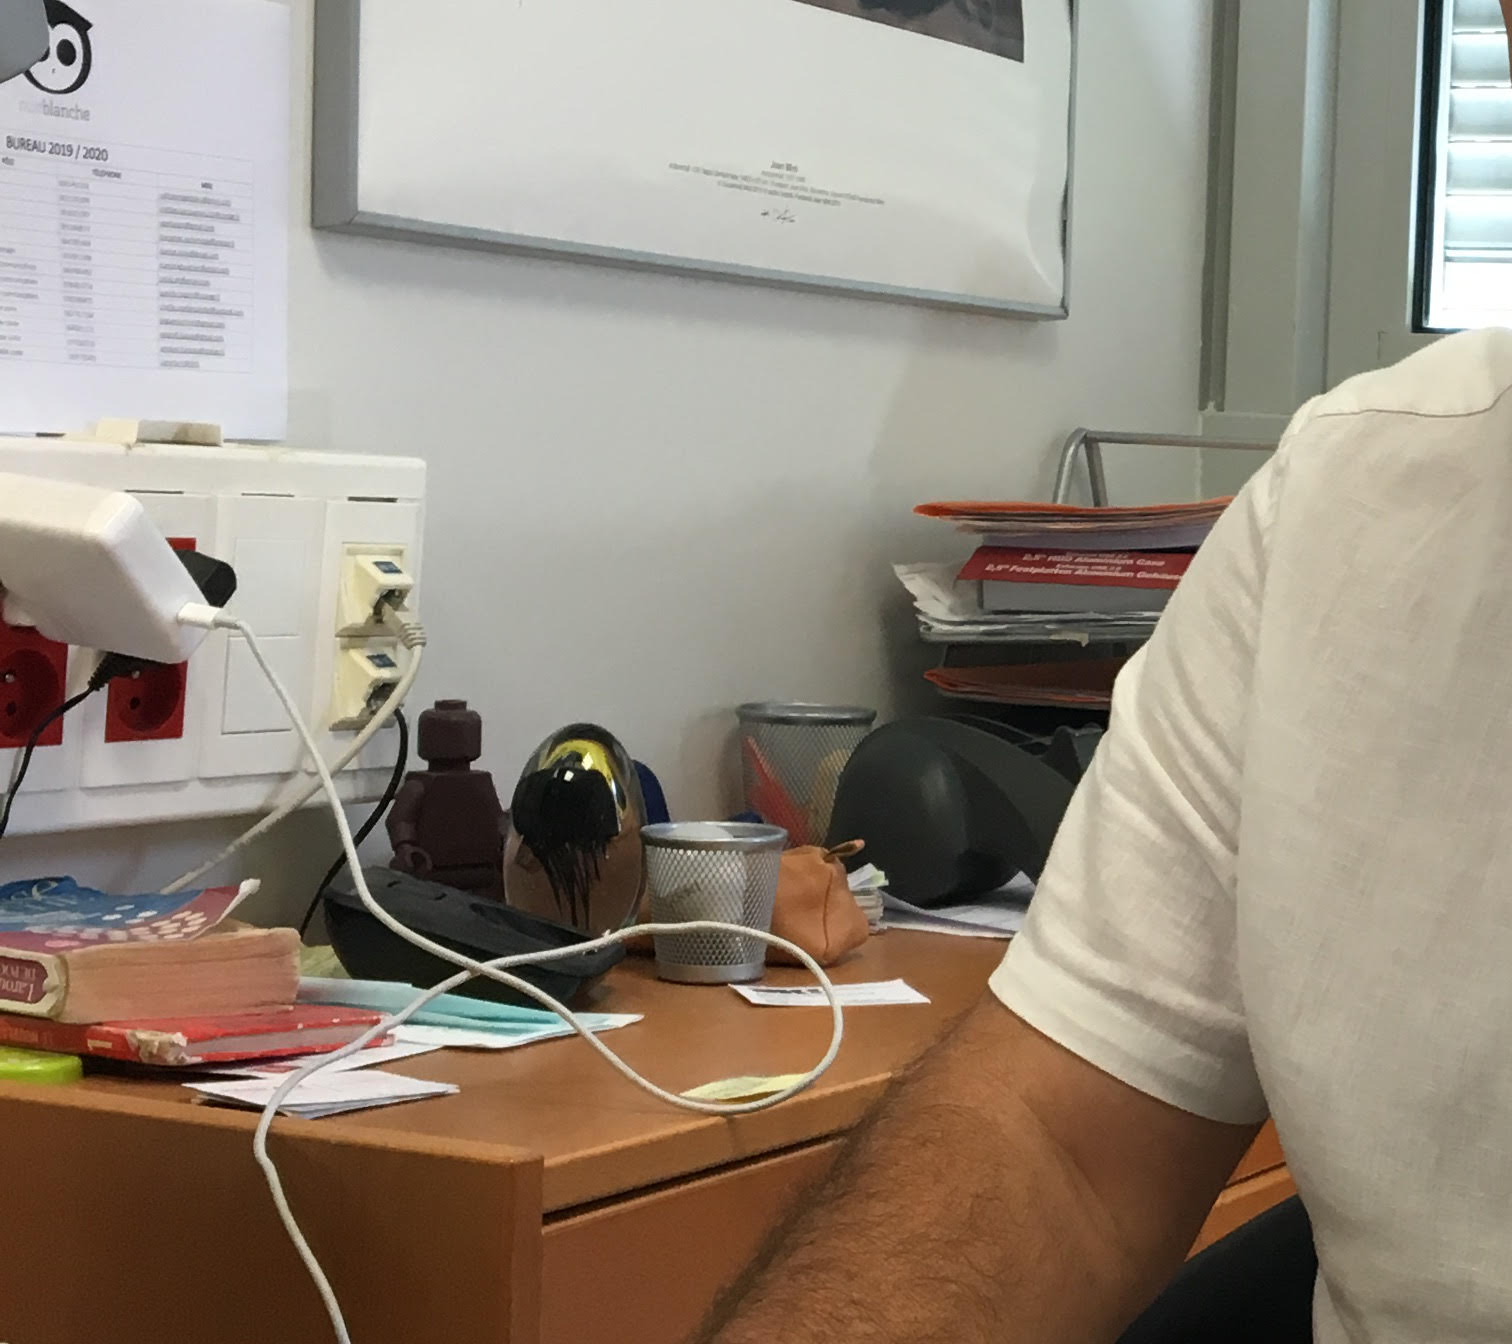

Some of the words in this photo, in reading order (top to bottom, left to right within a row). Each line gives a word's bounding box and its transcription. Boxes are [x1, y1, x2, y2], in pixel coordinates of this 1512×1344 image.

[6, 135, 46, 154] BUREAU
[48, 141, 74, 158] 2019
[82, 146, 109, 162] 2020
